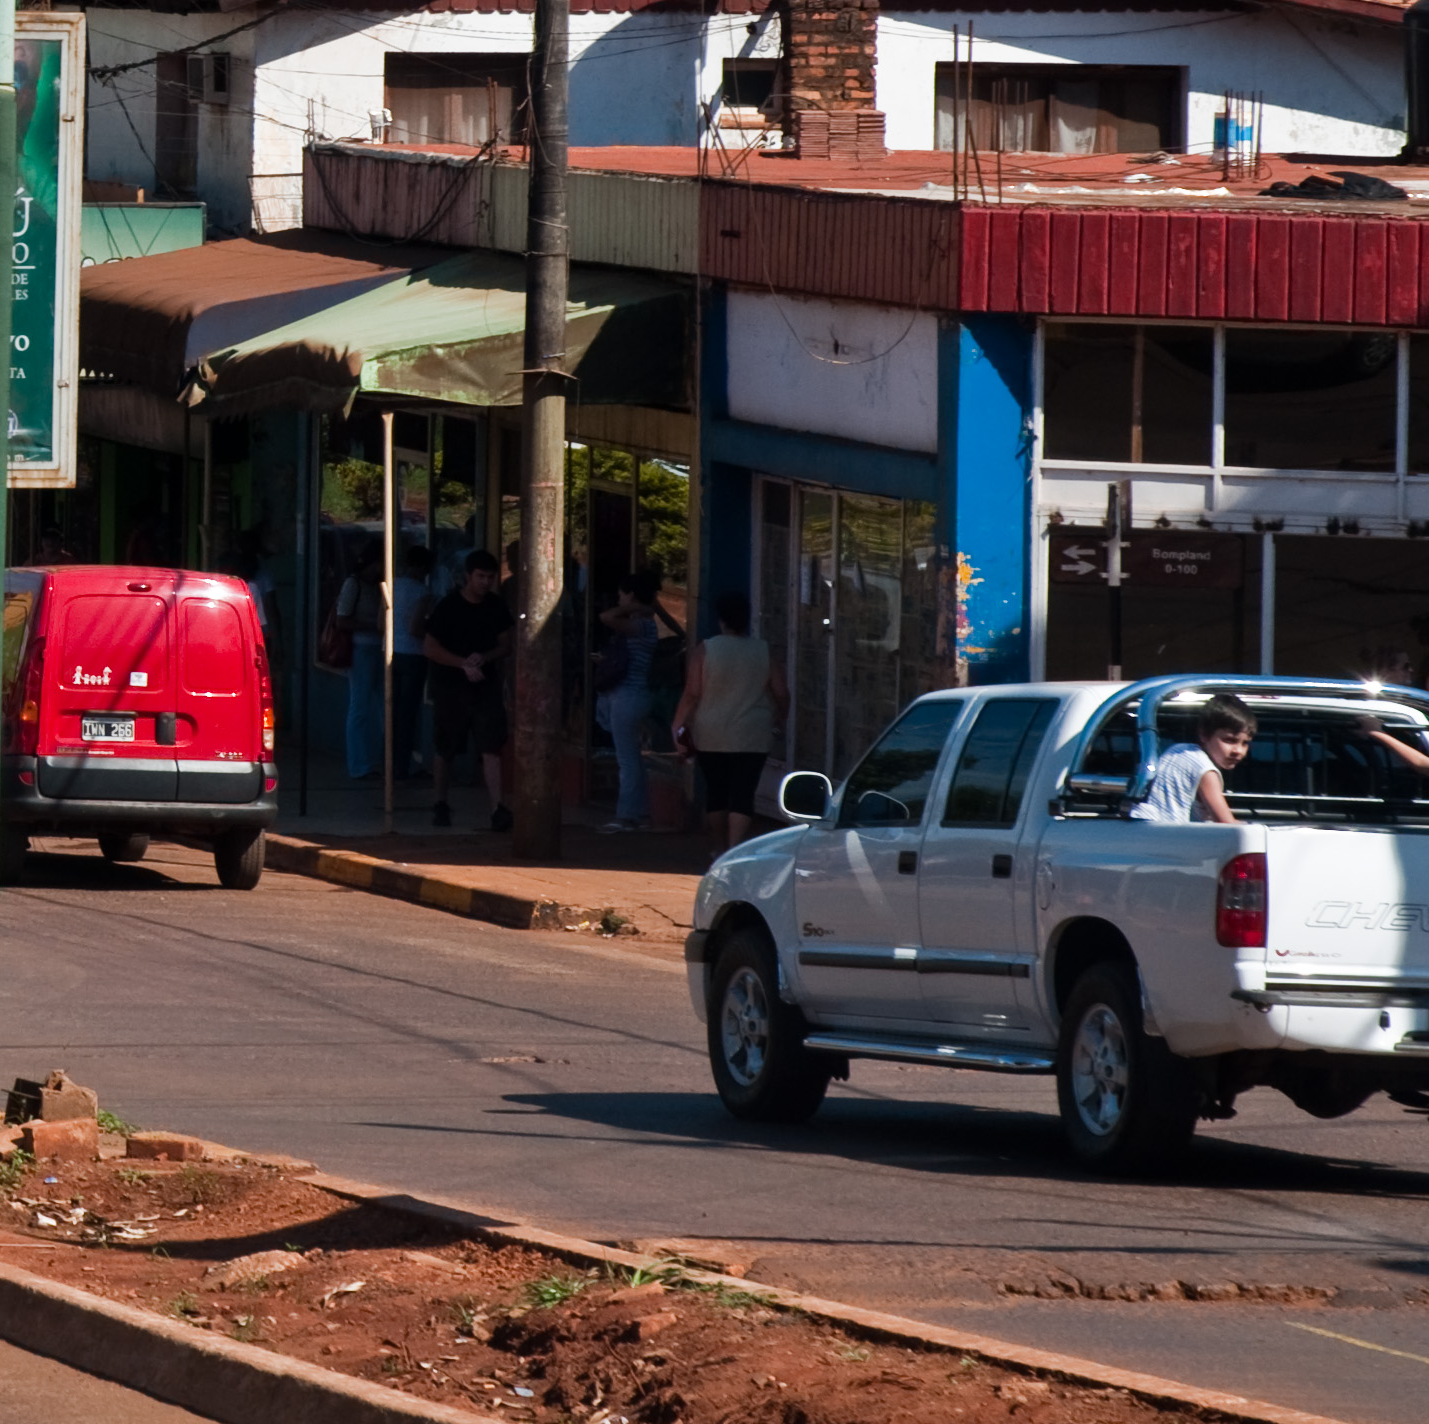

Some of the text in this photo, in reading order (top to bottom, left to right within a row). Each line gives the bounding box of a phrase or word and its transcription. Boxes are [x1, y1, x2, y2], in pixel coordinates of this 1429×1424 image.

[1152, 548, 1211, 562] Bompland
[1165, 564, 1198, 575] 0-100
[84, 723, 132, 737] IWN 266
